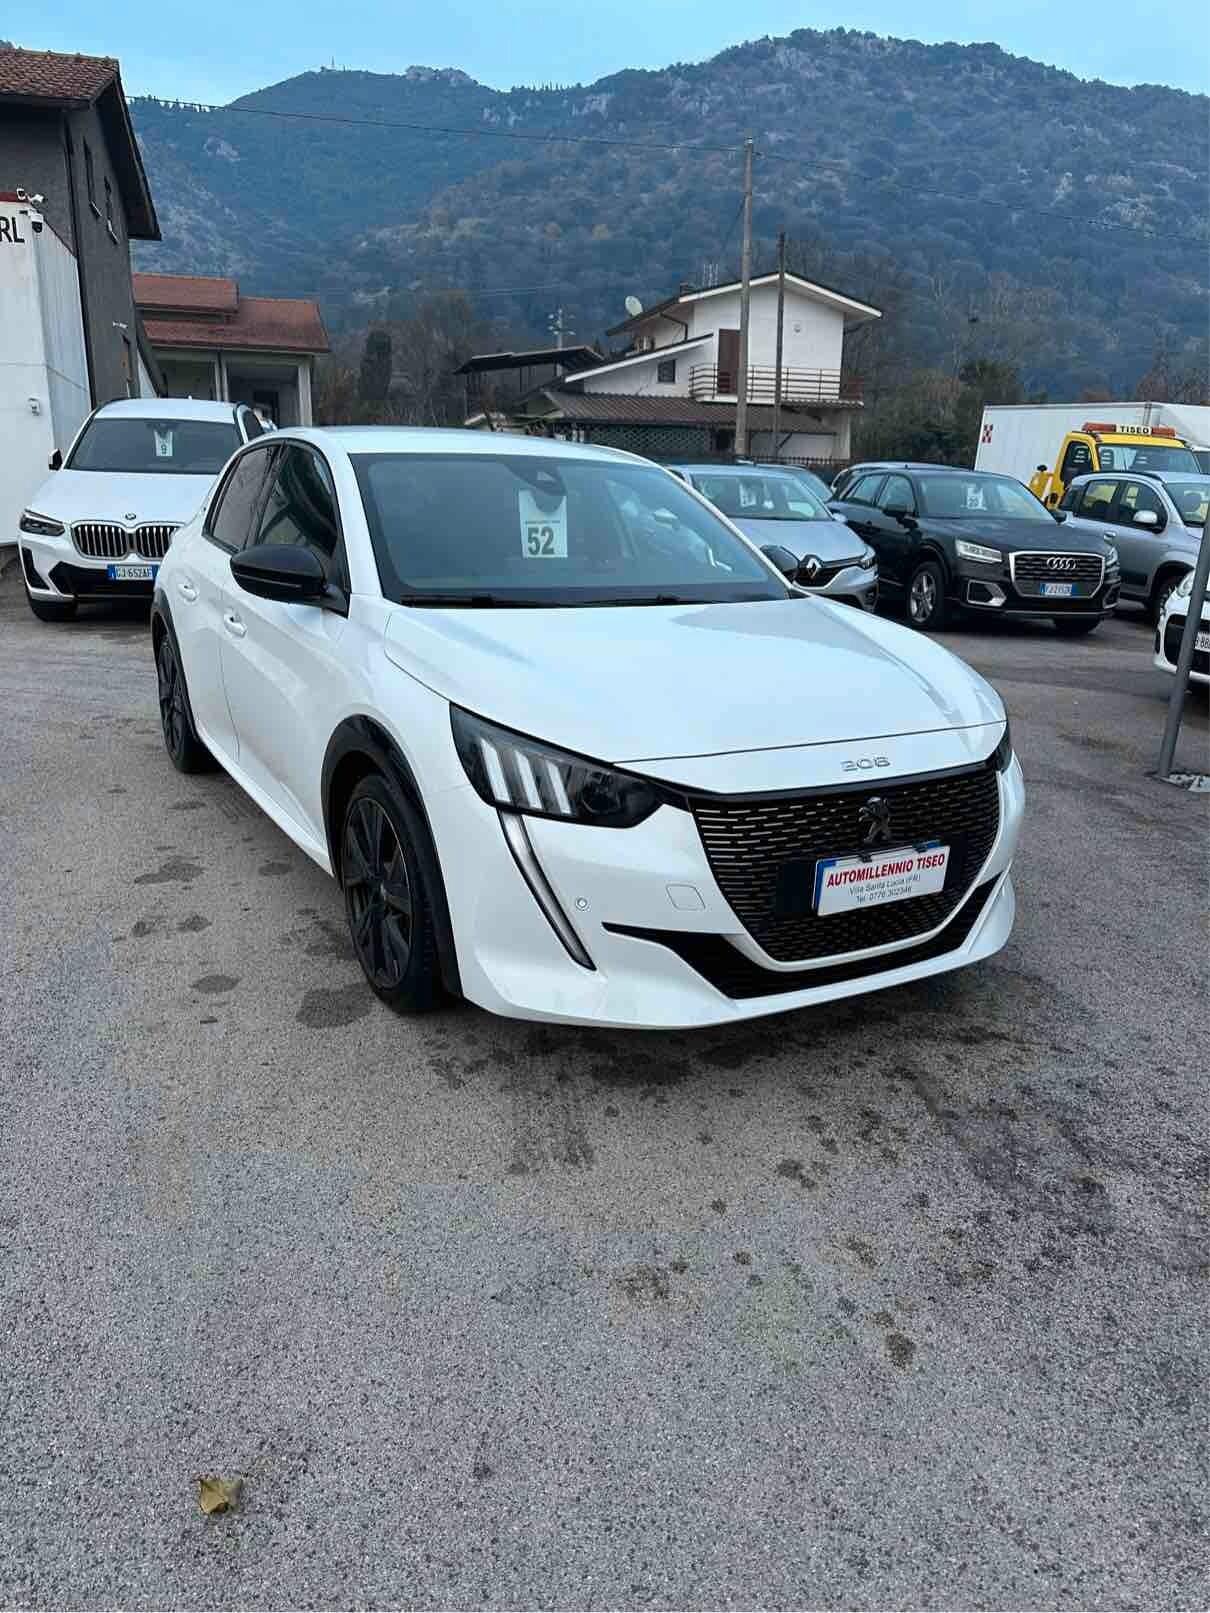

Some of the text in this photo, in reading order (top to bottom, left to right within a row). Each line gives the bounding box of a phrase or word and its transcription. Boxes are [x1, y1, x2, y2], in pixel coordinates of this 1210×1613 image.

[1120, 426, 1150, 434] TISEO
[527, 527, 554, 555] 52
[827, 853, 945, 888] AUTOMILLENNIO TISEO
